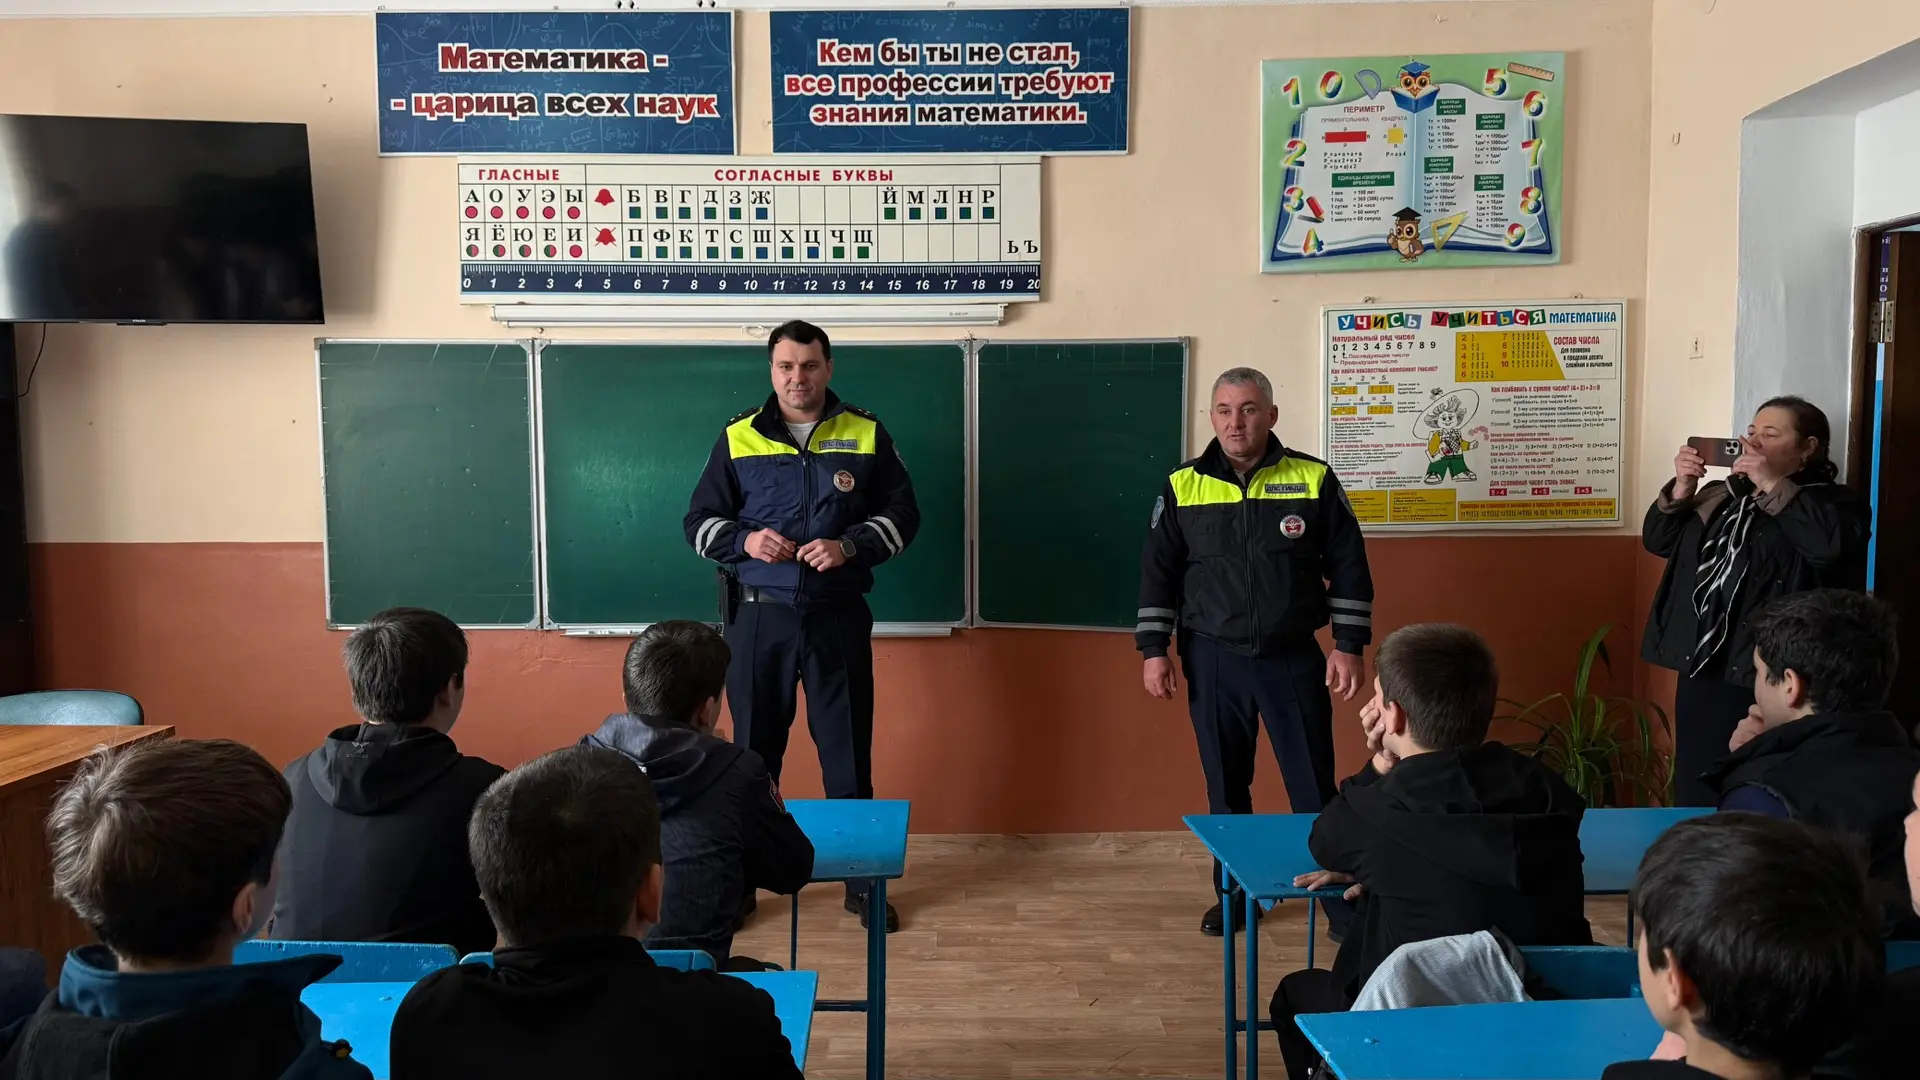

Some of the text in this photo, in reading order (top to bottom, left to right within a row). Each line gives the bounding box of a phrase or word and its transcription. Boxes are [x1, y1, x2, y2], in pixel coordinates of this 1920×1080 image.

[440, 45, 647, 70] Математика
[820, 41, 1077, 66] Кем бы ты не стал,
[787, 71, 1110, 100] все профессии требуют
[1282, 77, 1301, 106] 1
[1319, 70, 1343, 99] 0
[1485, 68, 1507, 96] 5
[413, 94, 536, 118] царица
[547, 95, 628, 113] всех
[637, 95, 717, 122] наук
[813, 104, 1085, 122] знания математики.
[1343, 105, 1385, 114] ПЕРИМЕТР
[1523, 90, 1545, 117] 6
[1283, 139, 1307, 168] 2
[1520, 138, 1543, 167] 7
[478, 169, 560, 181] ГЛАСНЫЕ
[714, 170, 894, 182] СОГЛАСНЫЕ БУКВЫ
[465, 190, 583, 203] А О У Э Ы
[627, 187, 995, 205] Б В Г Д З Ж Й М Л Н Р
[1284, 186, 1305, 212] 3
[1519, 186, 1542, 215] 8
[465, 224, 583, 241] Я Ё Ю Е И
[628, 229, 874, 246] П Ф К Т С Ш Х Ц Ч Щ
[1303, 227, 1324, 254] 4
[1504, 222, 1526, 247] 9
[463, 278, 1040, 291] 0 1 2 3 4 5 6 7 8 9 10 11 12 13 14 15 16 17 18 19 20
[1340, 310, 1544, 329] УЧИСЬ УЧИТЬСЯ
[1549, 311, 1617, 324] МАТЕМАТИКА
[1386, 342, 1391, 350] 5
[1430, 341, 1436, 349] 9
[1553, 336, 1600, 345] СОСТАВ ЧИСЛА
